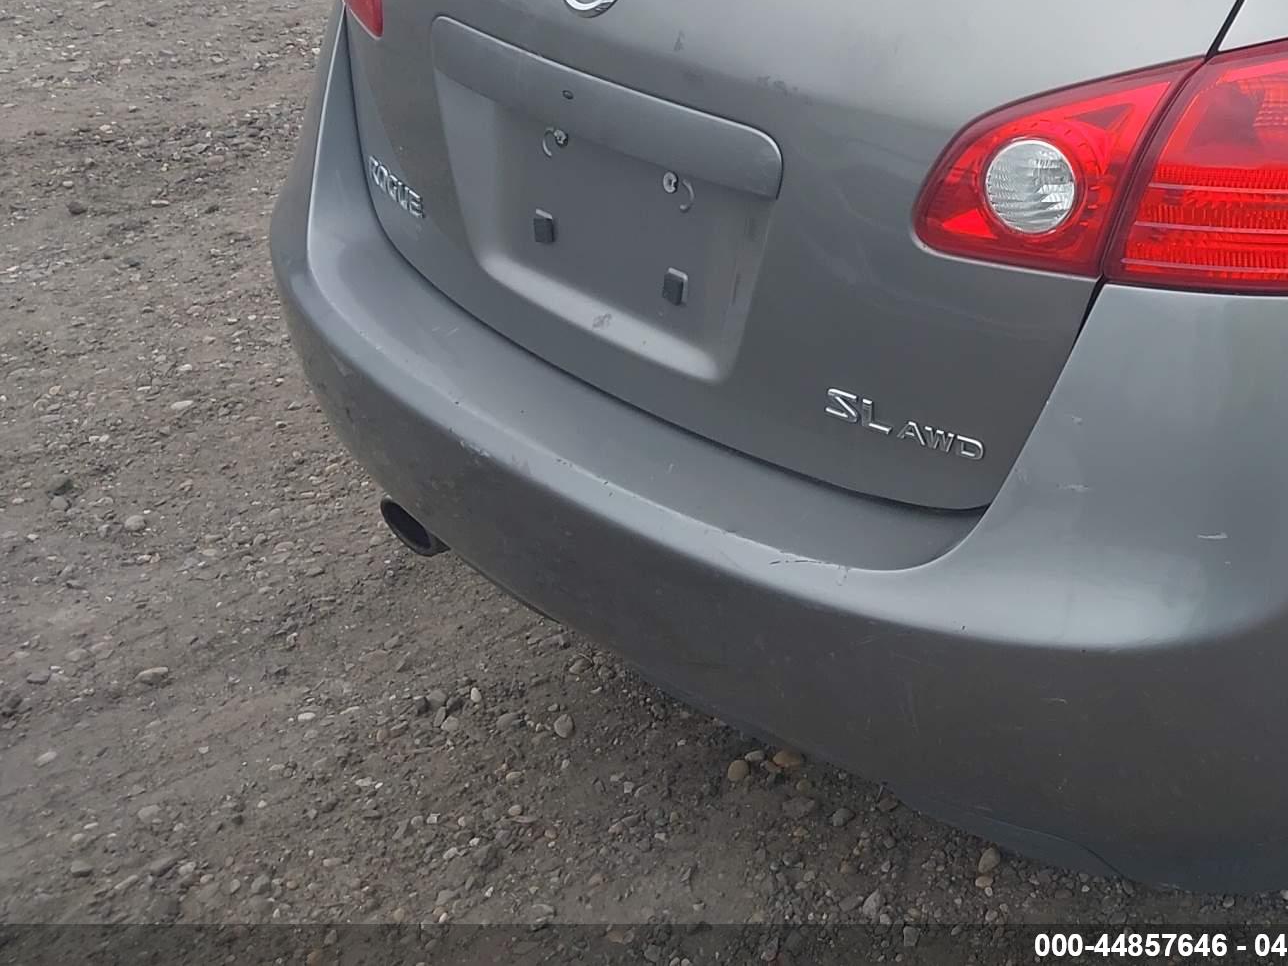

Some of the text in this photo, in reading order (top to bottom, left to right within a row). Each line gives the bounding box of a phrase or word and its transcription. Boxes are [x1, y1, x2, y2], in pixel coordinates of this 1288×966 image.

[368, 155, 424, 218] ROGUE
[825, 388, 985, 461] SL AWD
